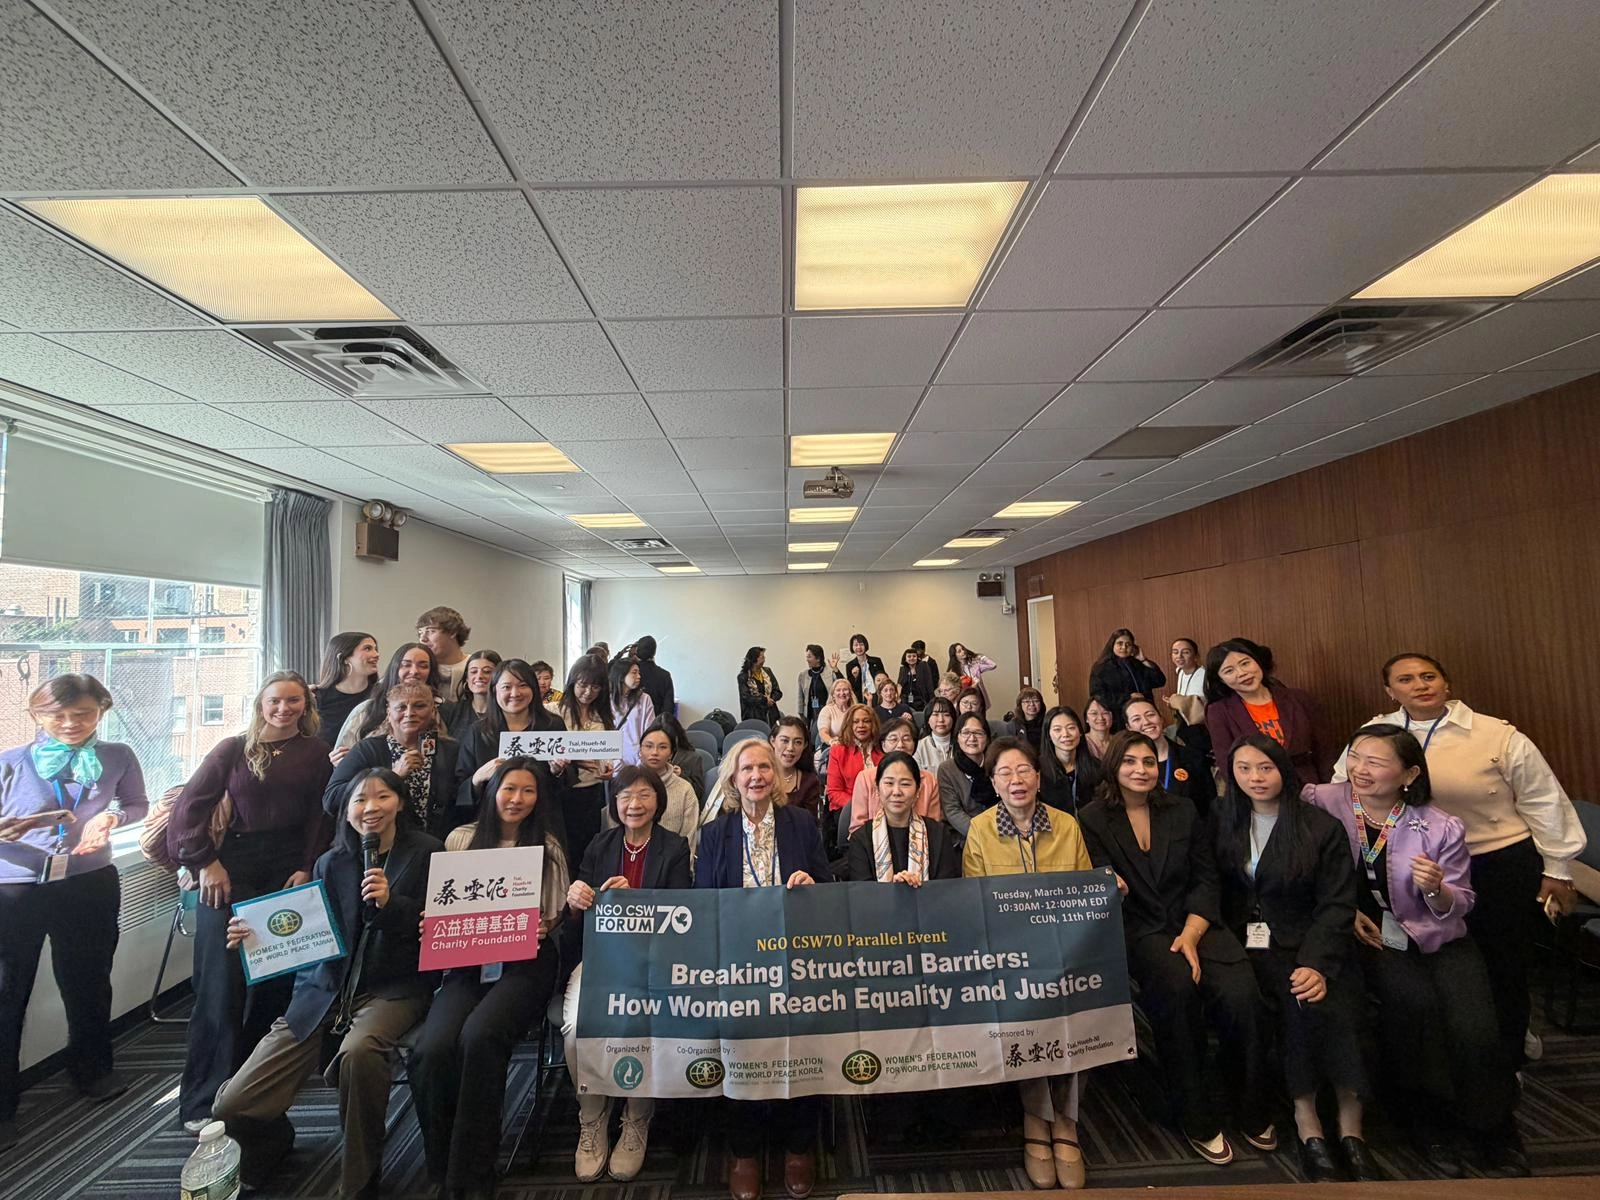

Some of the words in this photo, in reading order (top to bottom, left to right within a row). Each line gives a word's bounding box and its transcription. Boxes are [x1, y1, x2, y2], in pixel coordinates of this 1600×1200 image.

[993, 890, 1032, 900] Tuesday,
[1034, 887, 1063, 897] March
[1066, 886, 1080, 895] 10,
[1083, 883, 1106, 893] 2026
[1090, 896, 1108, 906] EDT
[595, 904, 622, 916] NGO
[626, 905, 655, 916] CSW
[1030, 914, 1060, 924] CCUN,
[1062, 912, 1084, 922] 11th
[1086, 911, 1110, 921] Floor
[432, 912, 529, 939] 公益慈善基金會
[598, 918, 652, 931] FORUM
[249, 943, 284, 957] WOMEN'S
[287, 930, 331, 947] FEDERATION
[431, 939, 468, 950] Charity
[472, 934, 527, 946] Foundation
[756, 936, 787, 952] NGO
[792, 934, 843, 949] CSW70
[846, 932, 902, 947] Parallel
[907, 930, 948, 944] Event
[266, 950, 288, 960] WORLD
[291, 944, 310, 954] PEACE
[312, 938, 334, 947] TAIWAN
[671, 963, 783, 988] Breaking
[791, 954, 913, 981] Structural
[921, 950, 1029, 974] Barriers:
[607, 993, 662, 1015] How
[668, 995, 760, 1018] Women
[769, 989, 846, 1016] Reach
[854, 984, 952, 1014] Equality
[960, 979, 1007, 1003] and
[1014, 973, 1103, 1001] Justice
[988, 1028, 1025, 1039] Sponsored
[605, 1045, 640, 1054] Organized
[677, 1046, 721, 1056] Co-Organized
[729, 1061, 768, 1070] WOMEN'S
[772, 1057, 824, 1068] FEDERATION
[885, 1054, 922, 1065] WOMEN'S
[926, 1050, 976, 1062] FEDERATION
[729, 1071, 744, 1079] FOR
[745, 1070, 772, 1079] WORLD
[774, 1069, 796, 1078] PEACE
[798, 1066, 824, 1076] KOREA
[901, 1064, 926, 1073] WORLD
[928, 1062, 950, 1071] PEACE
[952, 1060, 978, 1069] TAIWAN
